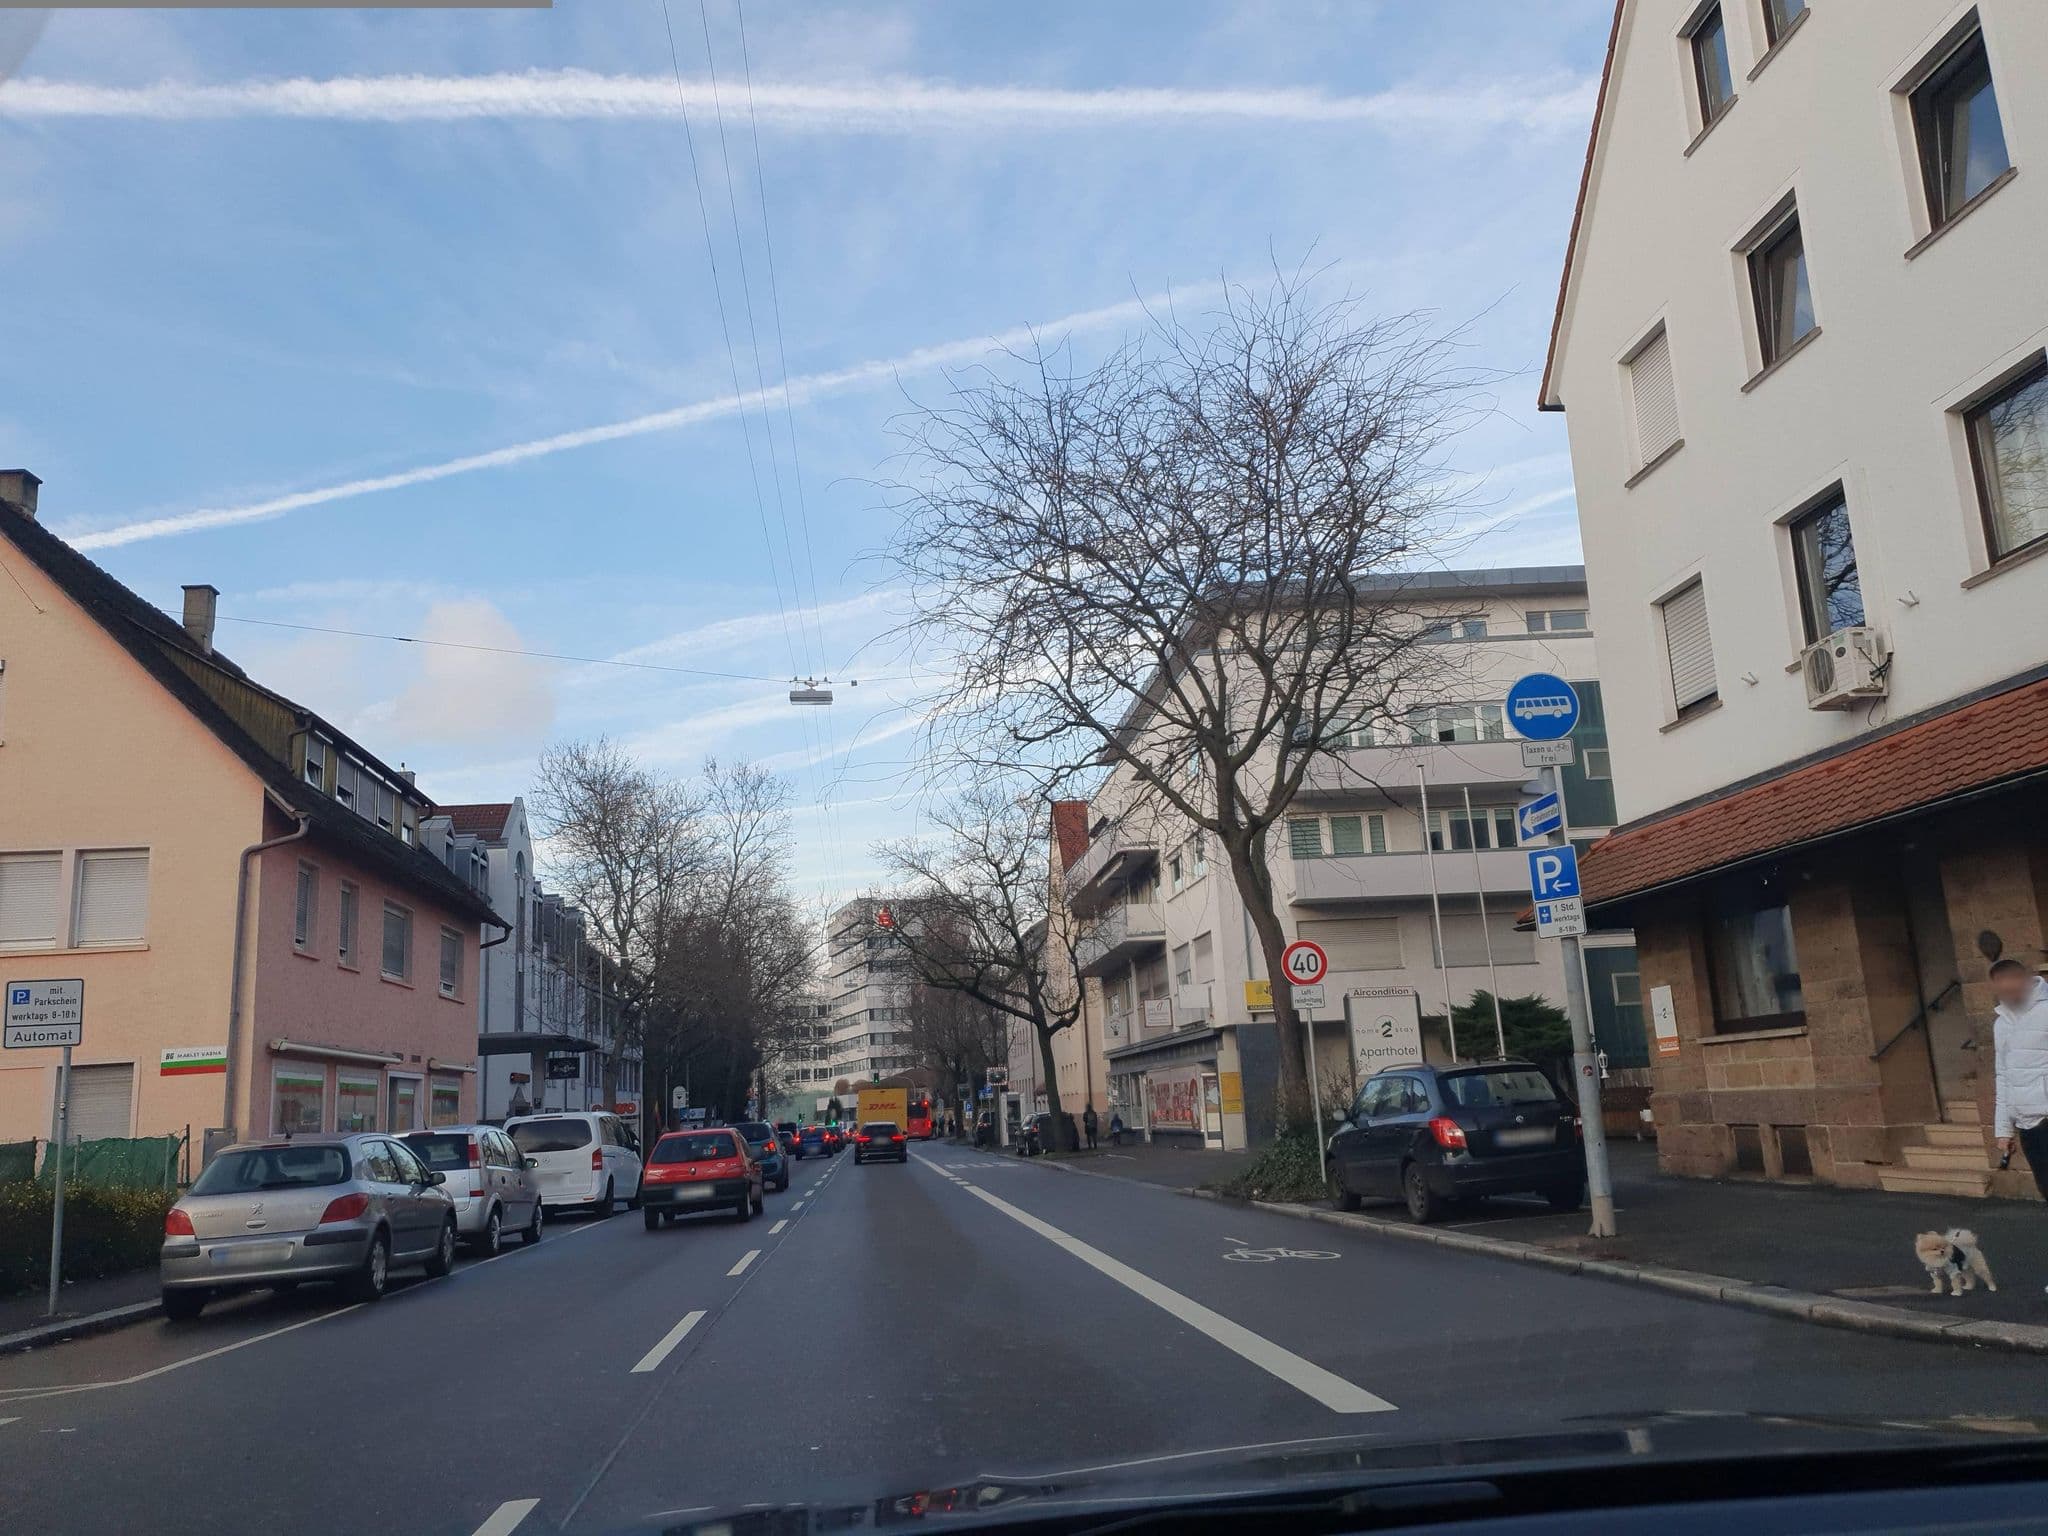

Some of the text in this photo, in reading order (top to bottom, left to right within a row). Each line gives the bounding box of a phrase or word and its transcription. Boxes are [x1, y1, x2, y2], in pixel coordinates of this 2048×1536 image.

[1541, 753, 1557, 762] frei
[1536, 855, 1562, 895] P
[1560, 902, 1576, 912] Std.
[1554, 914, 1580, 923] werktags
[1293, 953, 1319, 973] 40
[49, 986, 63, 994] mit
[1353, 987, 1409, 996] Aircondition
[34, 997, 77, 1006] Parkschein
[12, 1012, 48, 1021] werktags
[13, 1030, 73, 1042] Automat
[1360, 1046, 1418, 1059] Aparthotel
[868, 1102, 897, 1110] DHL
